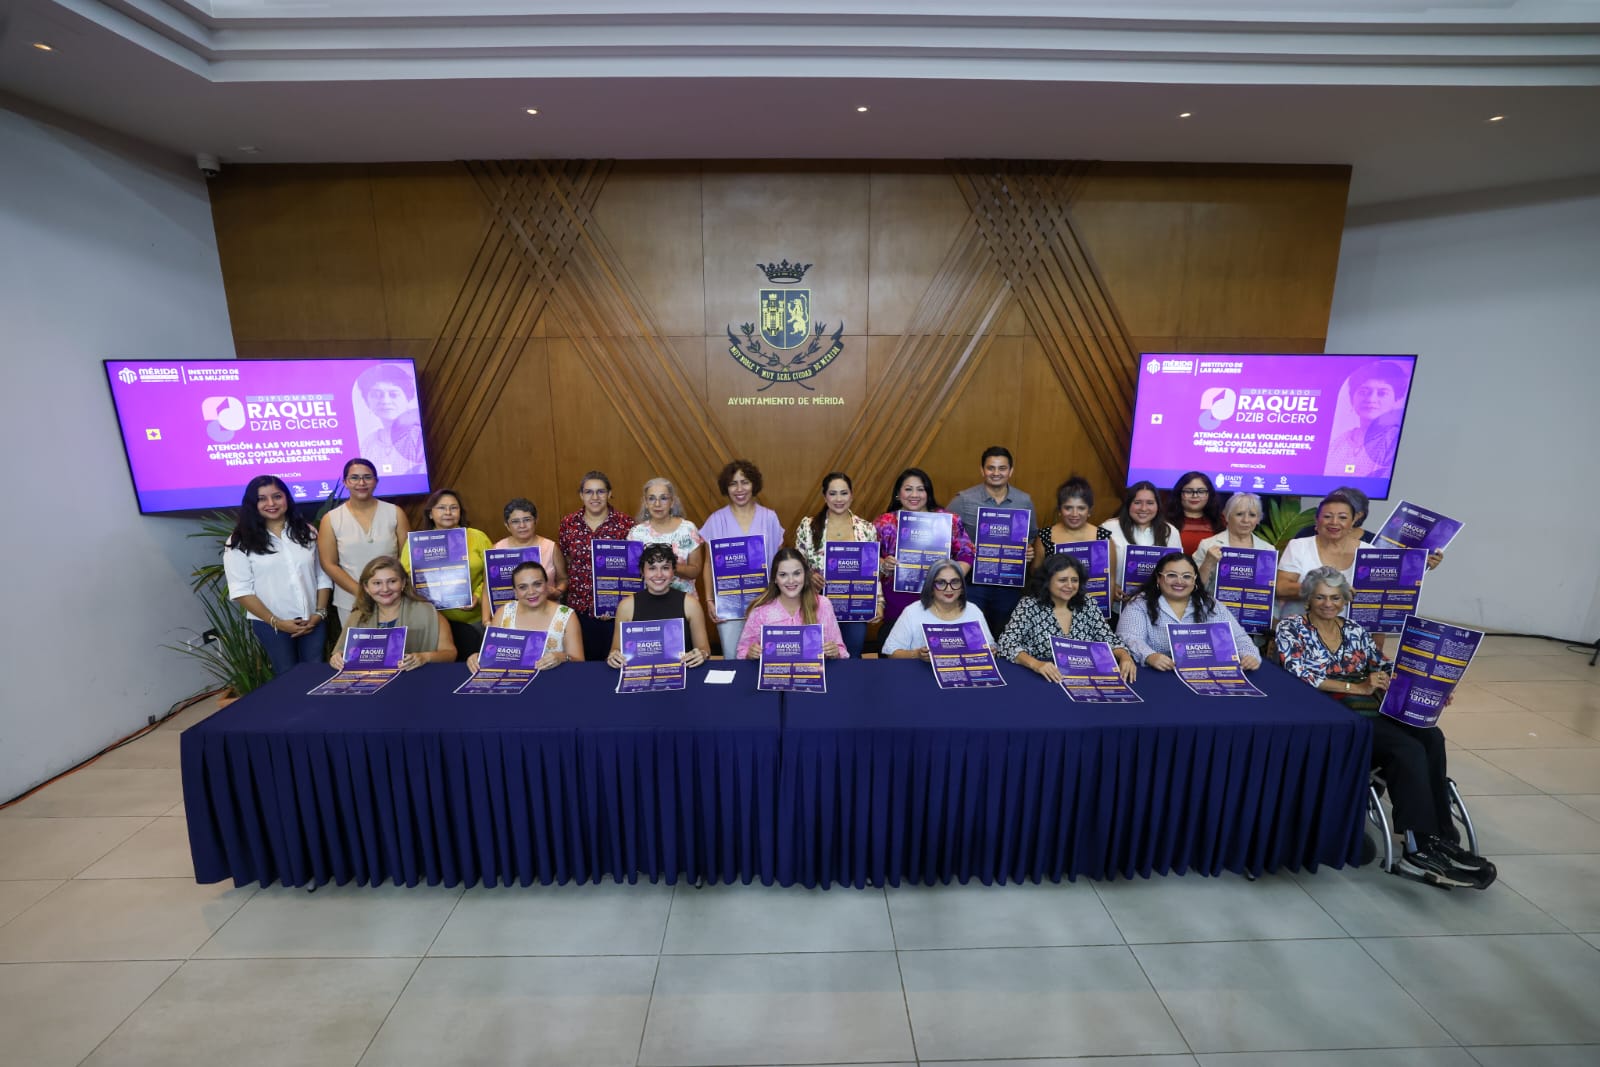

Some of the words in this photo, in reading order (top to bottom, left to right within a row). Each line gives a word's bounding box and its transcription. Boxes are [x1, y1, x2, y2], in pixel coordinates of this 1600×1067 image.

[728, 397, 794, 406] AYUNTAMIENTO
[798, 397, 809, 406] DE
[812, 395, 844, 406] MÉRIDA
[1238, 395, 1319, 412] RAQUEL
[247, 401, 336, 419] RAQUEL
[1236, 412, 1264, 422] DZIB
[250, 420, 281, 431] DZIB
[1193, 430, 1232, 439] ATENCIÓN
[1257, 433, 1304, 441] VIOLENCIAS
[207, 441, 252, 452] ATENCIÓN
[281, 439, 330, 448] VIOLENCIAS
[1193, 439, 1224, 447] GÉNERO
[1225, 440, 1256, 448] CONTRA
[209, 450, 246, 460] GÉNERO
[248, 450, 284, 458] CONTRA
[226, 458, 254, 466] NIÑAS
